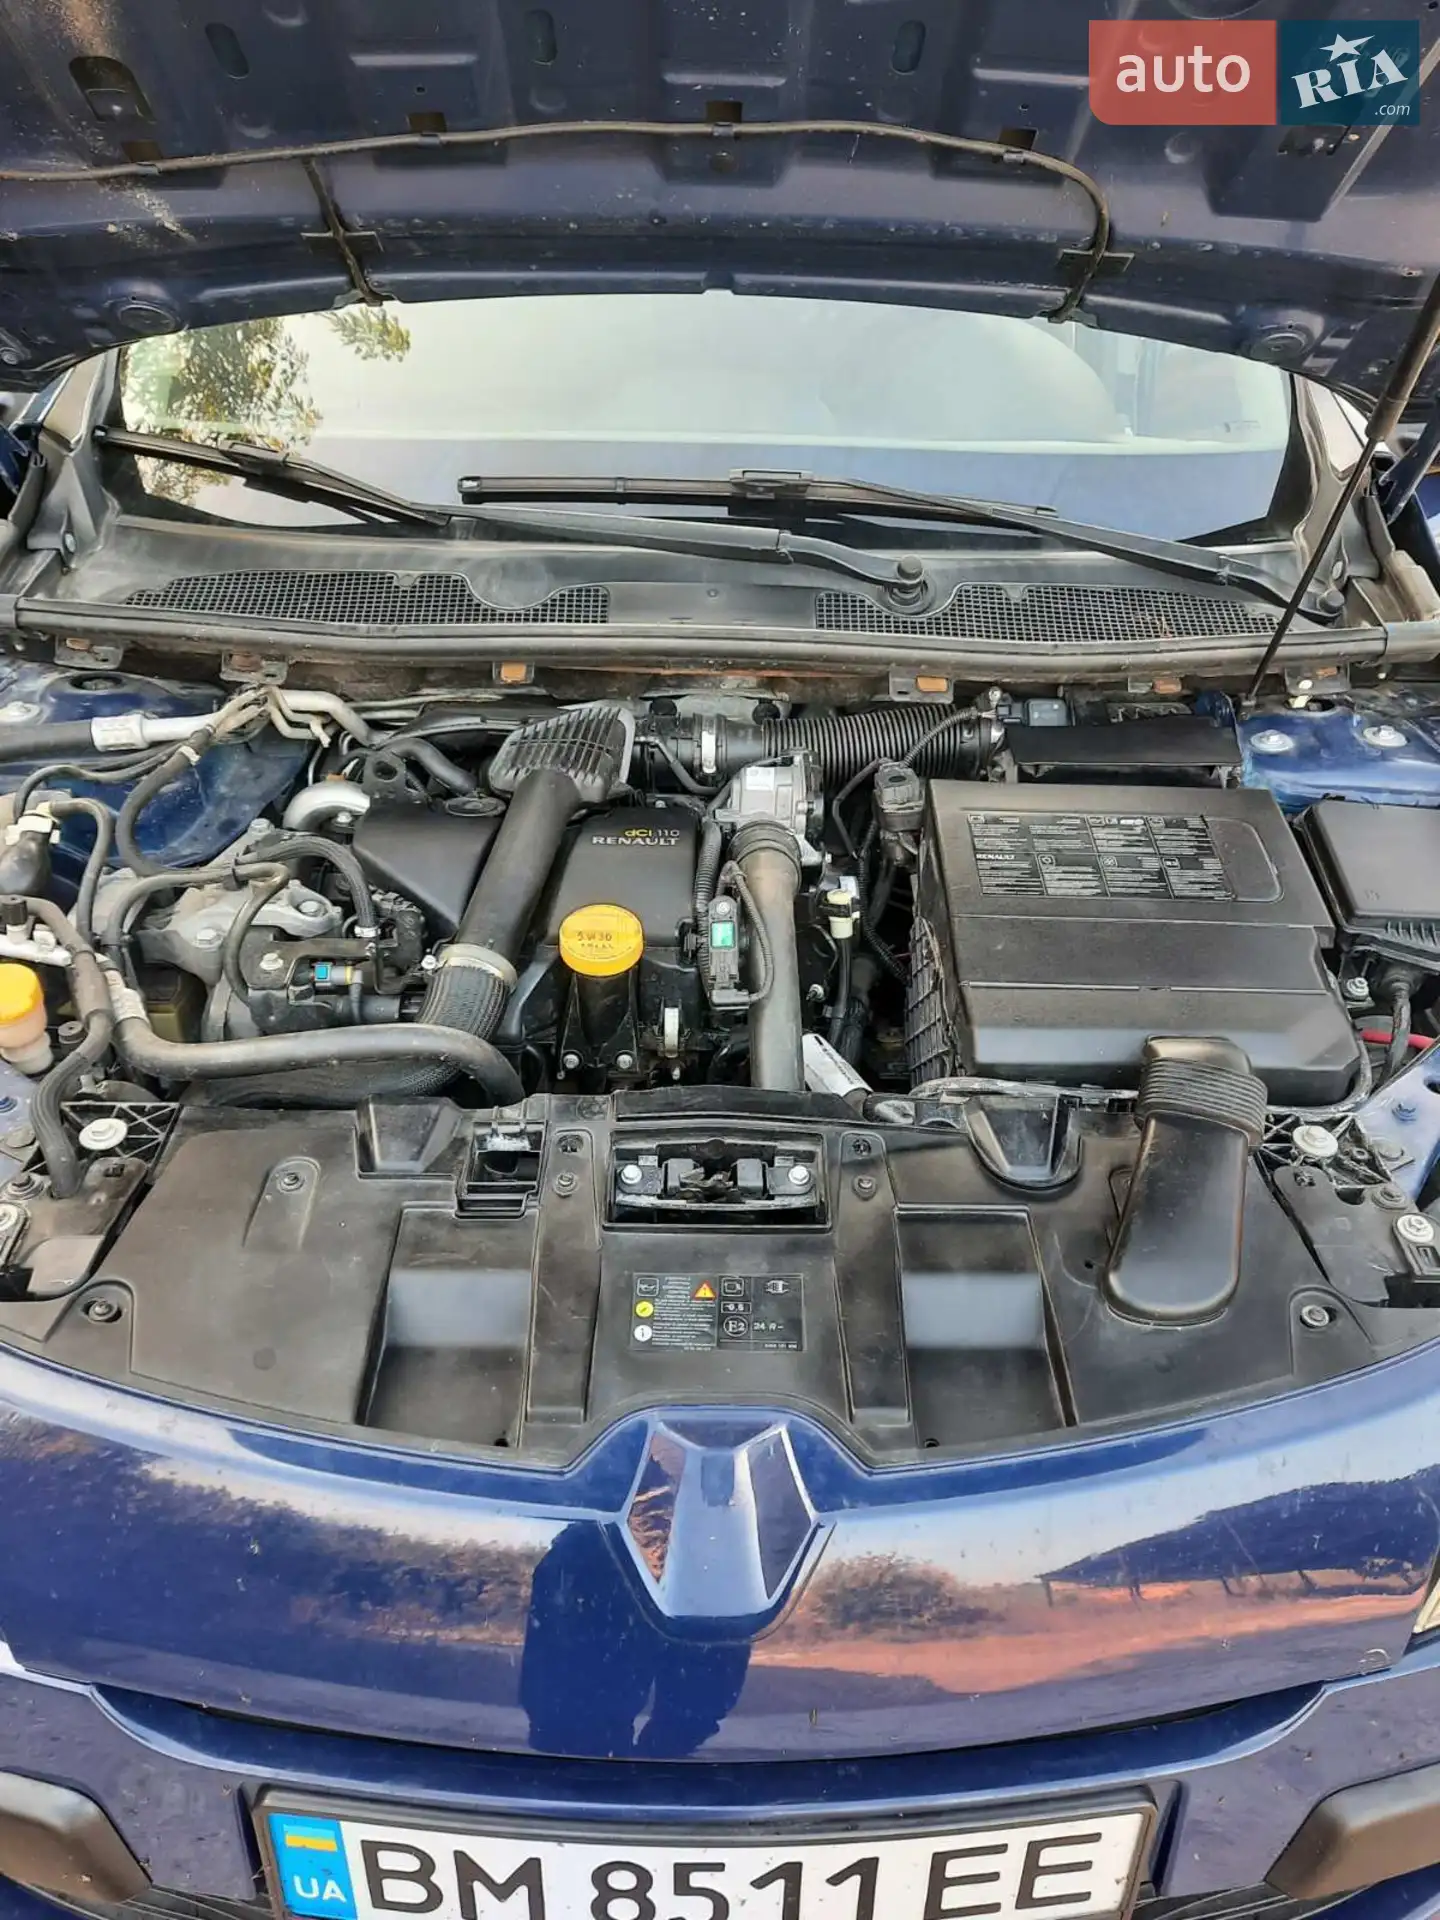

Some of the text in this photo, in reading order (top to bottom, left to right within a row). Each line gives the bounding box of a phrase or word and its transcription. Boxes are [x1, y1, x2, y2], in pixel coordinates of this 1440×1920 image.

[592, 836, 680, 846] RENAULT
[658, 828, 681, 837] 110
[360, 1832, 1102, 1920] BM 8511 EE
[293, 1875, 348, 1902] UA
